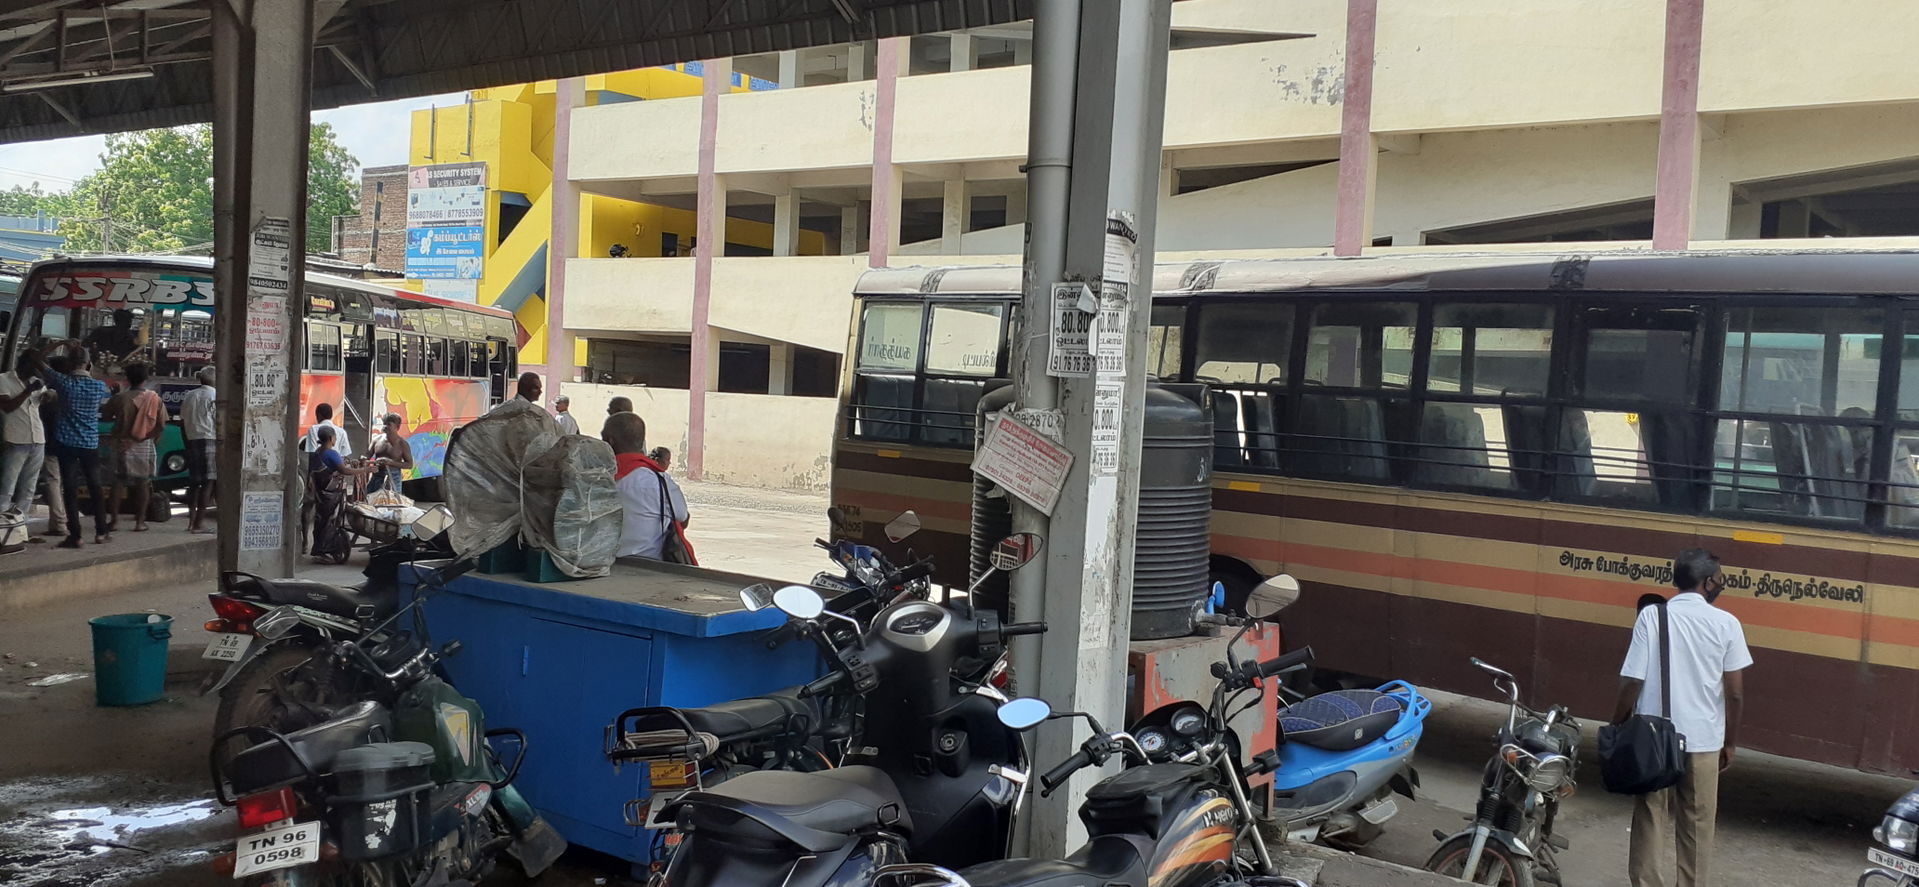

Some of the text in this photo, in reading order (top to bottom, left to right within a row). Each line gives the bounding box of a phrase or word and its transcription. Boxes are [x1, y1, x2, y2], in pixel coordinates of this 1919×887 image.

[434, 168, 460, 178] SECURITY
[460, 167, 482, 177] SYSTEM
[447, 208, 484, 218] 8778553909
[1559, 551, 1593, 572] அரசு
[249, 830, 306, 850] TN 96
[254, 847, 301, 865] 0598
